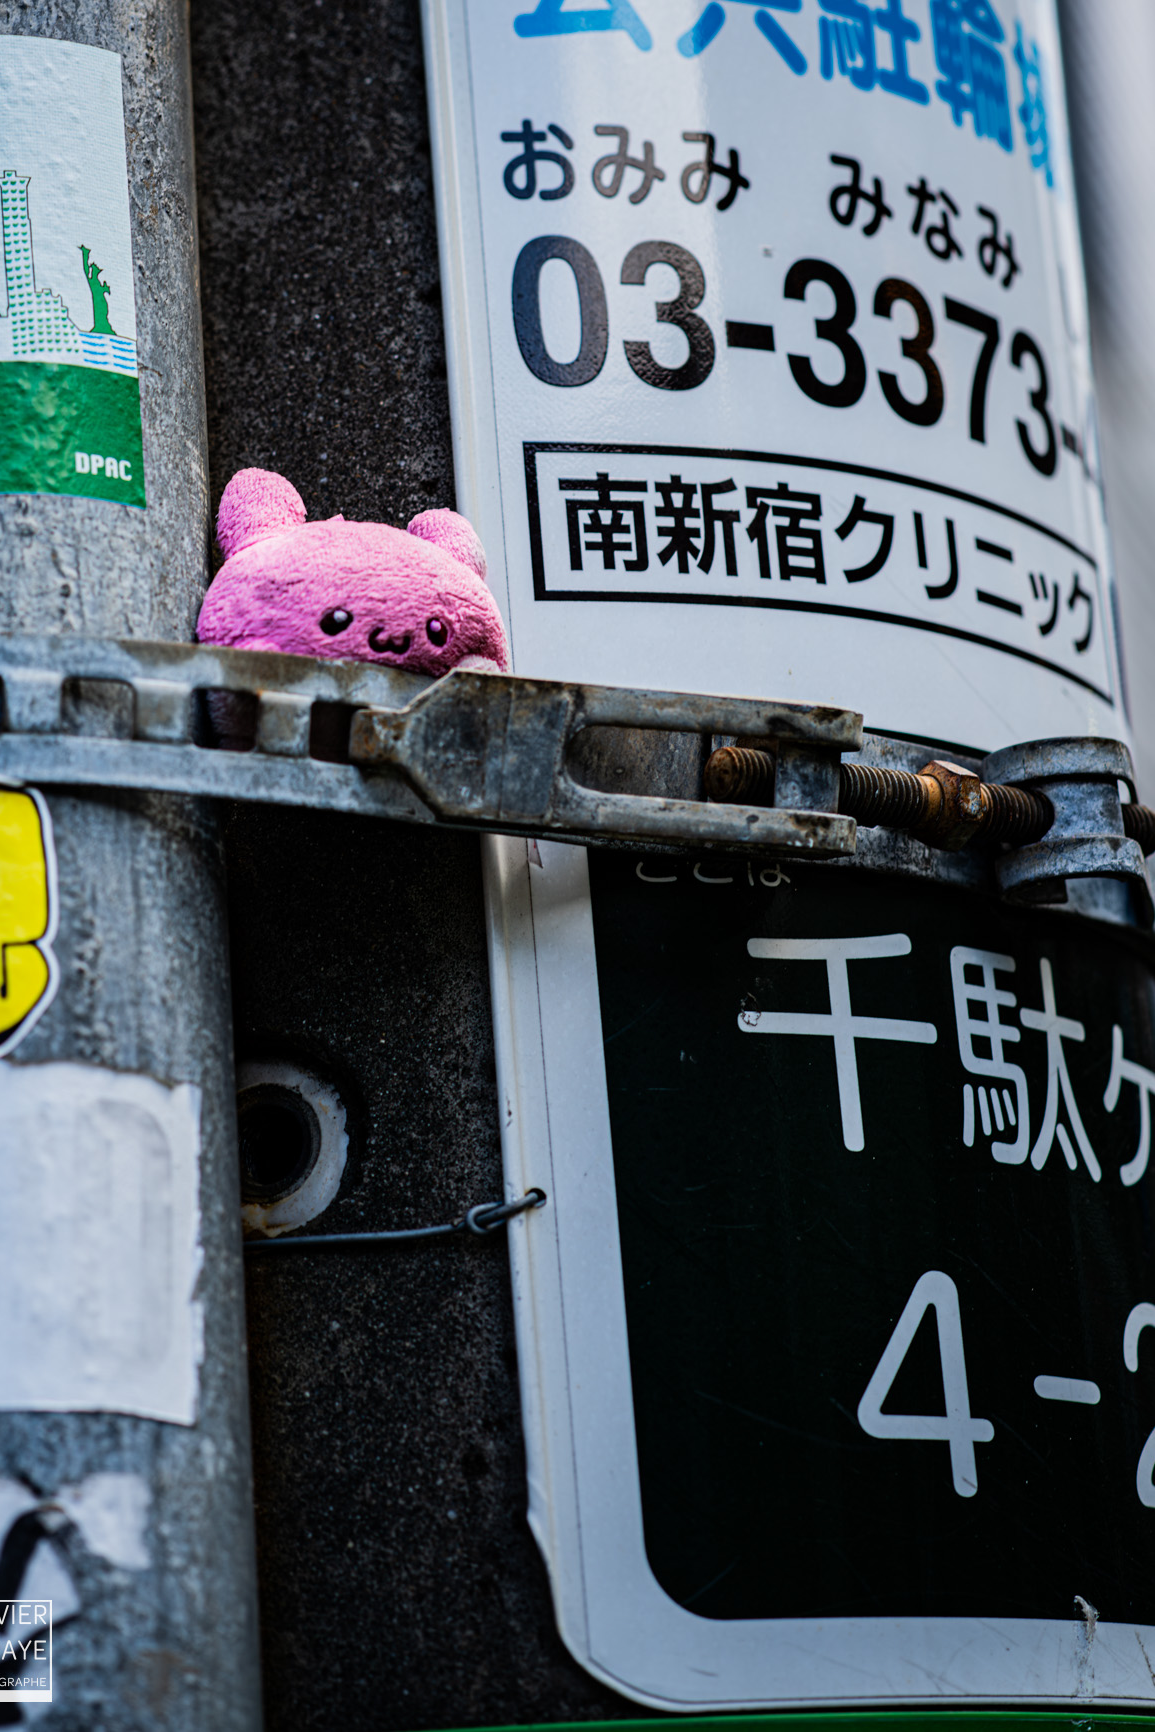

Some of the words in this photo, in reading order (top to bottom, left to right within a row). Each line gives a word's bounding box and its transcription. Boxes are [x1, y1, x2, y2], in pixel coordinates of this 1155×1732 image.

[500, 118, 751, 212] おみみ
[828, 152, 1023, 291] みなみ
[74, 451, 133, 482] DPAC
[557, 472, 1096, 655] 南新宿クリニック
